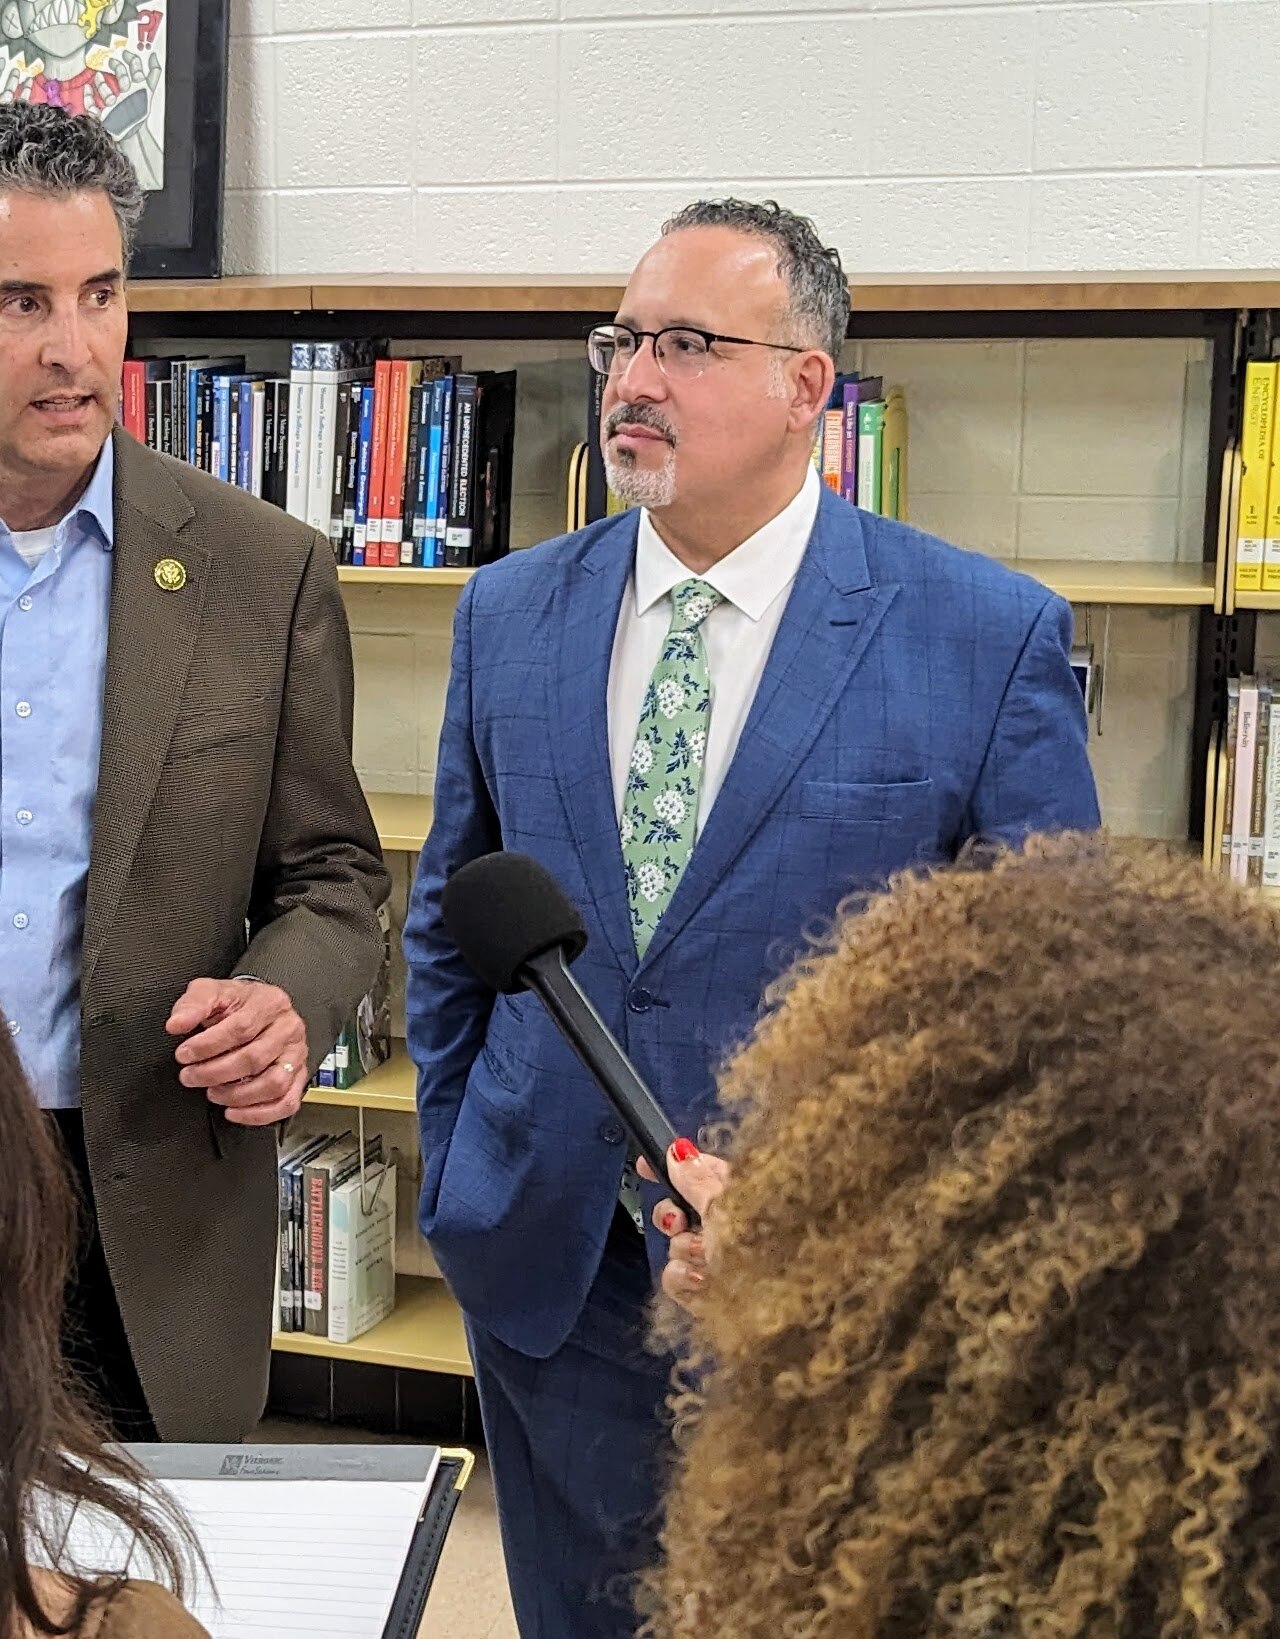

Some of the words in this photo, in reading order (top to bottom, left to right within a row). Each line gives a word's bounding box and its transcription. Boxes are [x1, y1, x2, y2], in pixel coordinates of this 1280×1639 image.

[463, 403, 471, 413] AN
[1250, 377, 1259, 426] ENERGY
[1259, 377, 1270, 447] ENCYCLOPEDIA
[317, 416, 325, 440] Suffrage
[461, 416, 470, 476] UNPRECEDENTED
[824, 417, 840, 474] FREAKONOMICS
[846, 431, 852, 439] an
[264, 435, 272, 471] Suppression
[278, 436, 286, 471] Suppression
[360, 441, 368, 472] Political
[1258, 449, 1265, 460] OF
[348, 458, 356, 488] Spending
[358, 475, 367, 516] Campaigns
[459, 478, 467, 516] ELECTION
[1241, 711, 1251, 748] Biodiversity
[311, 1177, 325, 1264] BATTLEGROUND
